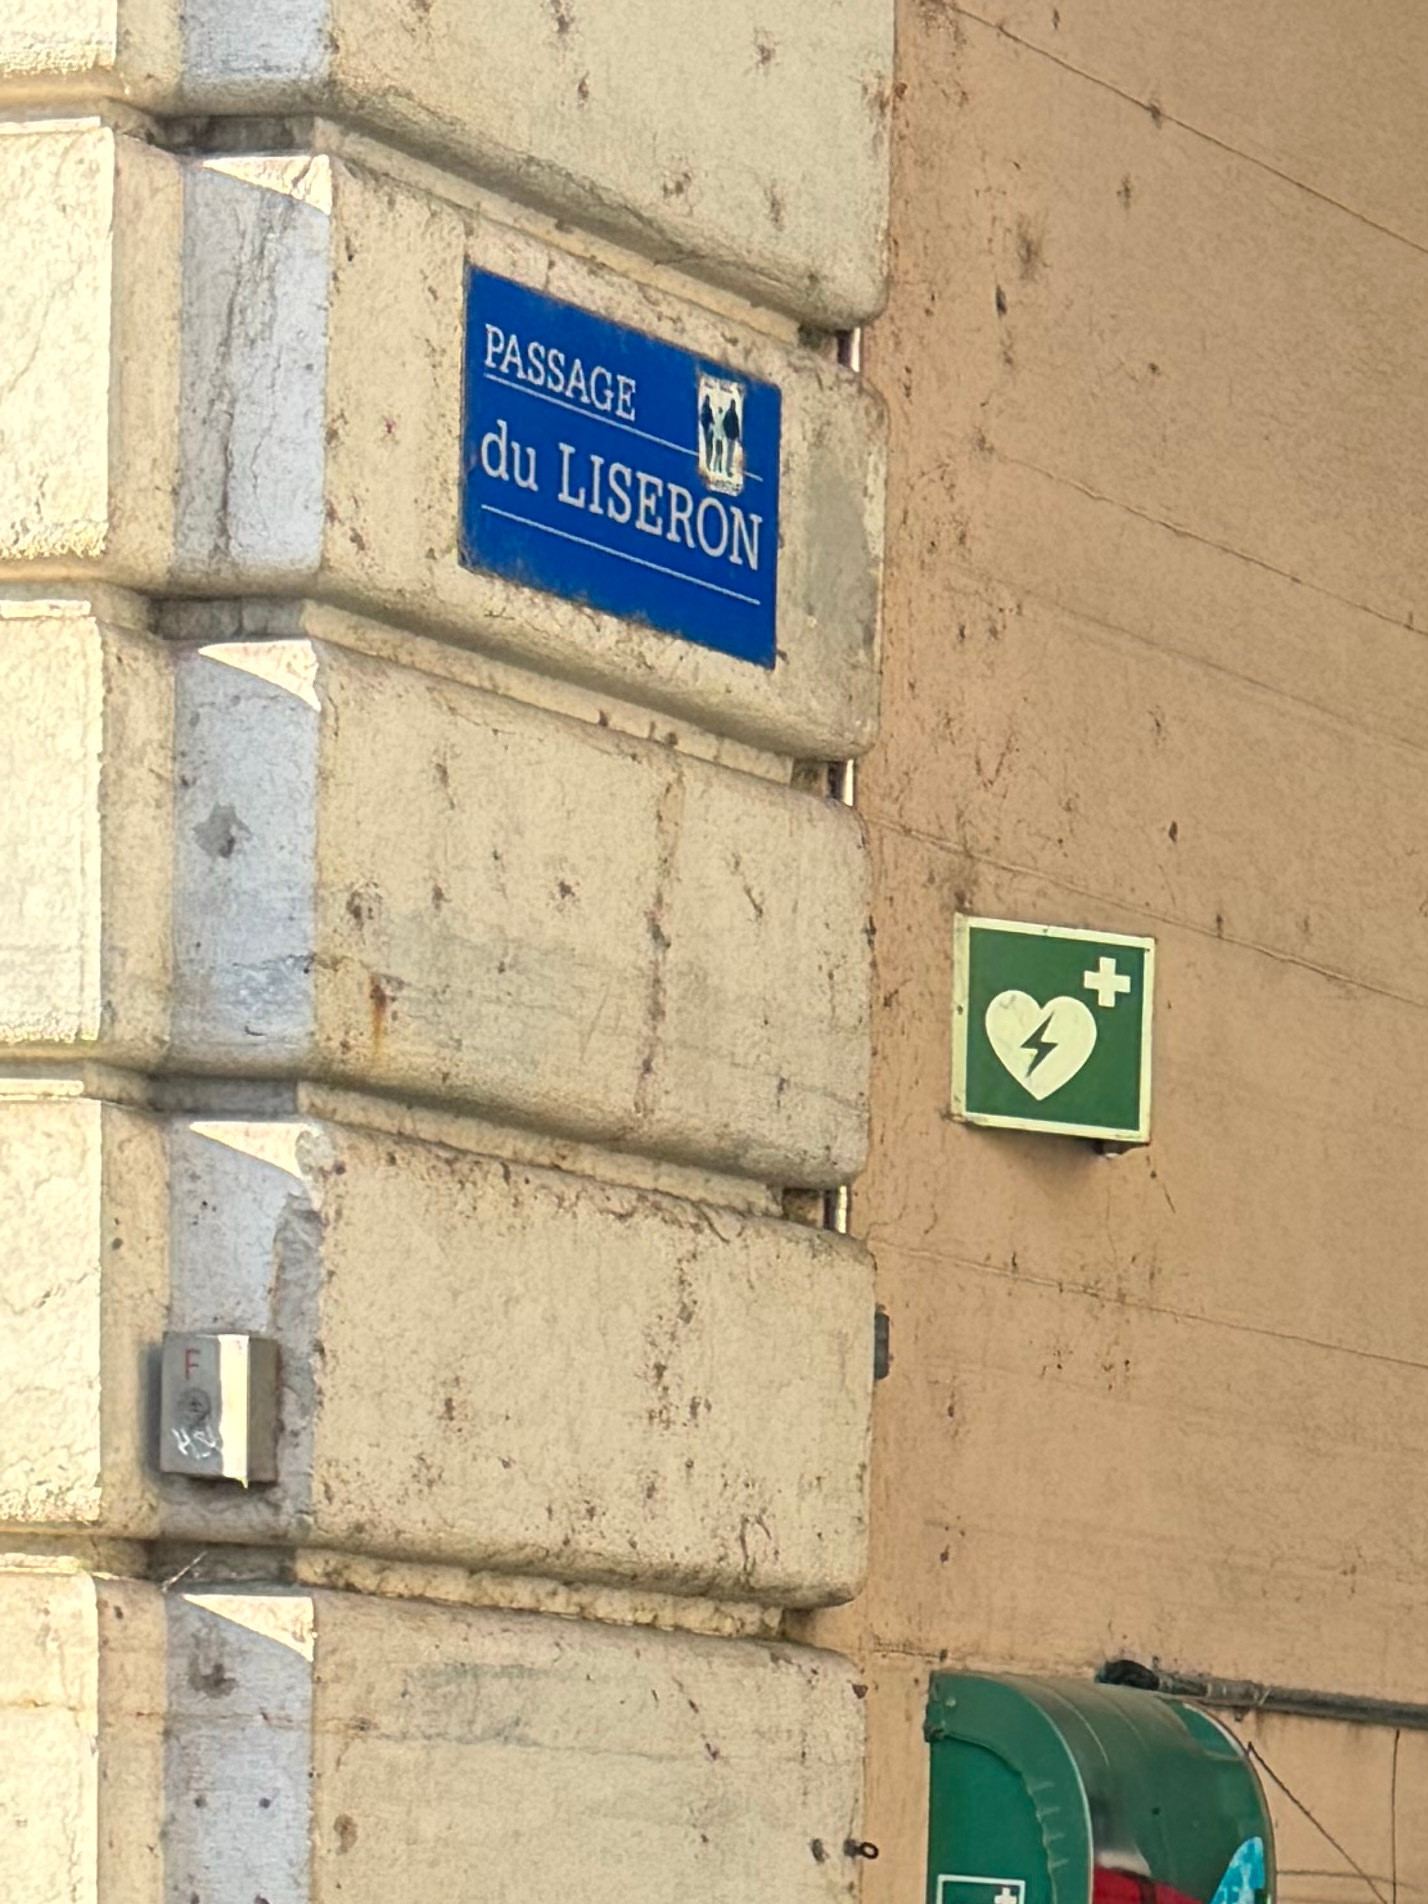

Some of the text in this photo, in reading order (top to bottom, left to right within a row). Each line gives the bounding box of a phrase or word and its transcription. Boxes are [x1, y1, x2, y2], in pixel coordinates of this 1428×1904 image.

[484, 323, 637, 422] PASSAGE
[480, 419, 763, 570] du LISERON
